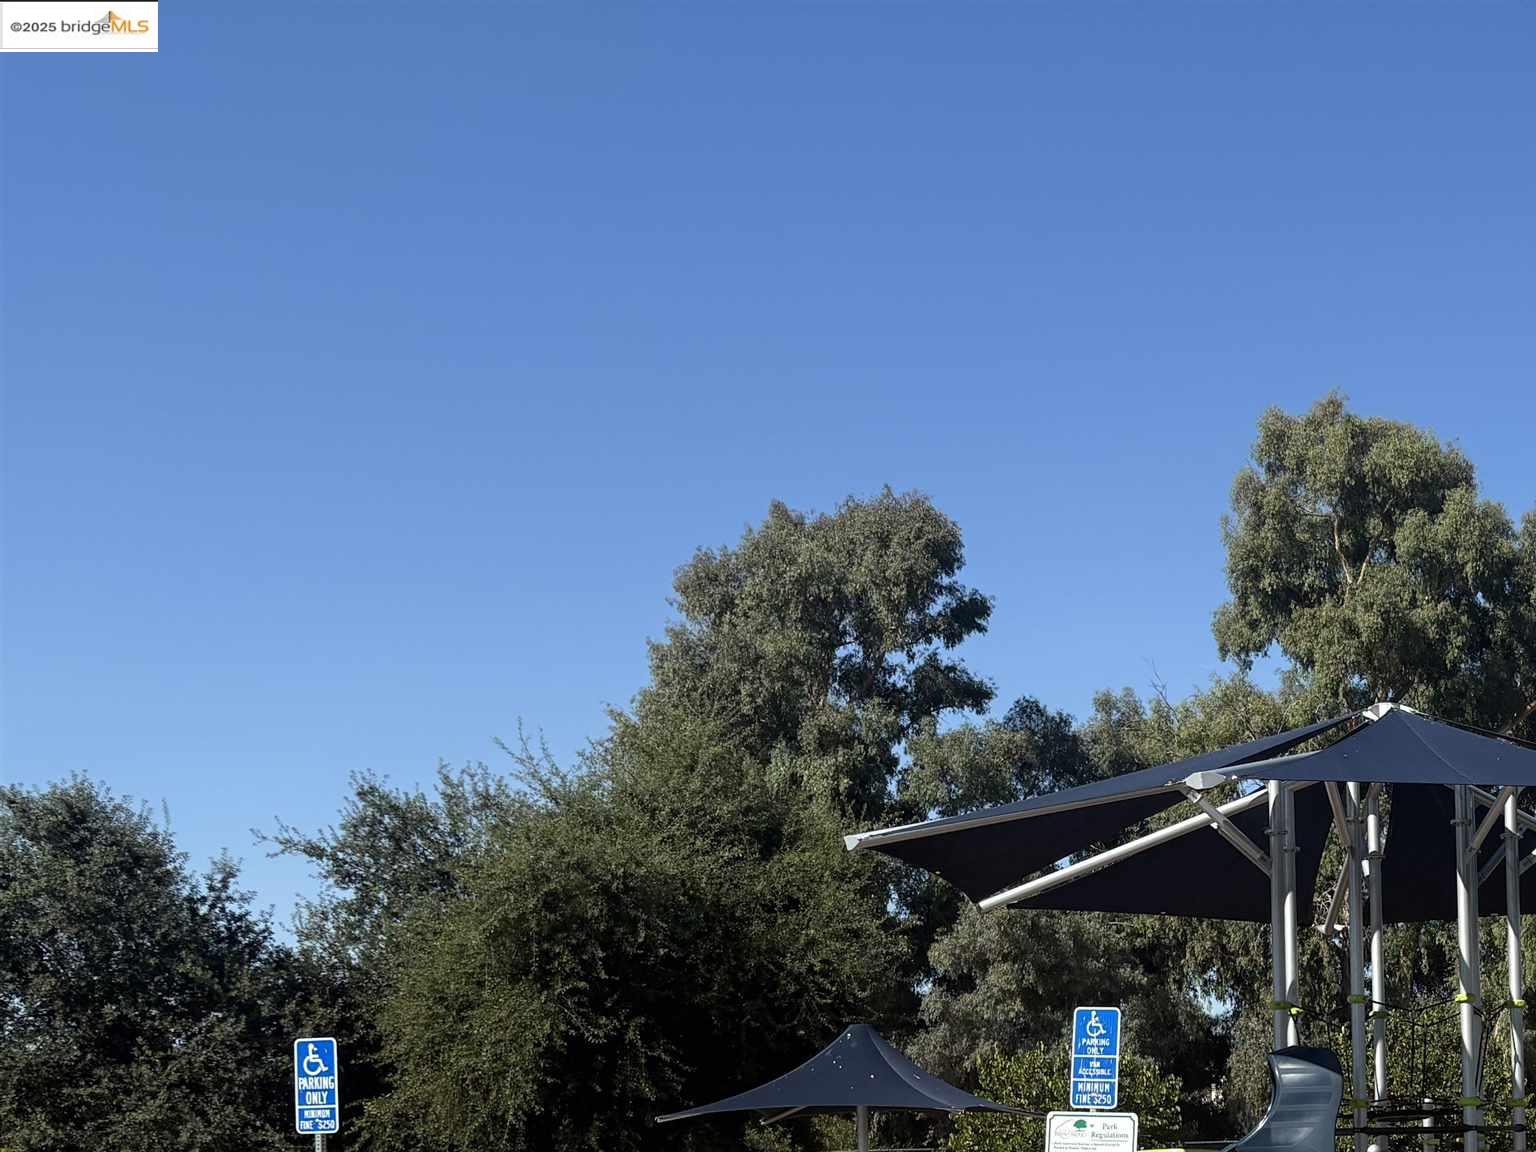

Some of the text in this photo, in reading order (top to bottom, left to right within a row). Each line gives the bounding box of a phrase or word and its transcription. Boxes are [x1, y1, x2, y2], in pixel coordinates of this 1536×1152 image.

[1081, 1038, 1110, 1047] PARKING
[1086, 1046, 1104, 1055] ONLY
[298, 1076, 335, 1090] PARKING
[1077, 1082, 1110, 1093] MINIMUM
[305, 1091, 329, 1105] ONLY
[1075, 1094, 1112, 1104] FINE $250
[300, 1119, 313, 1130] FINE
